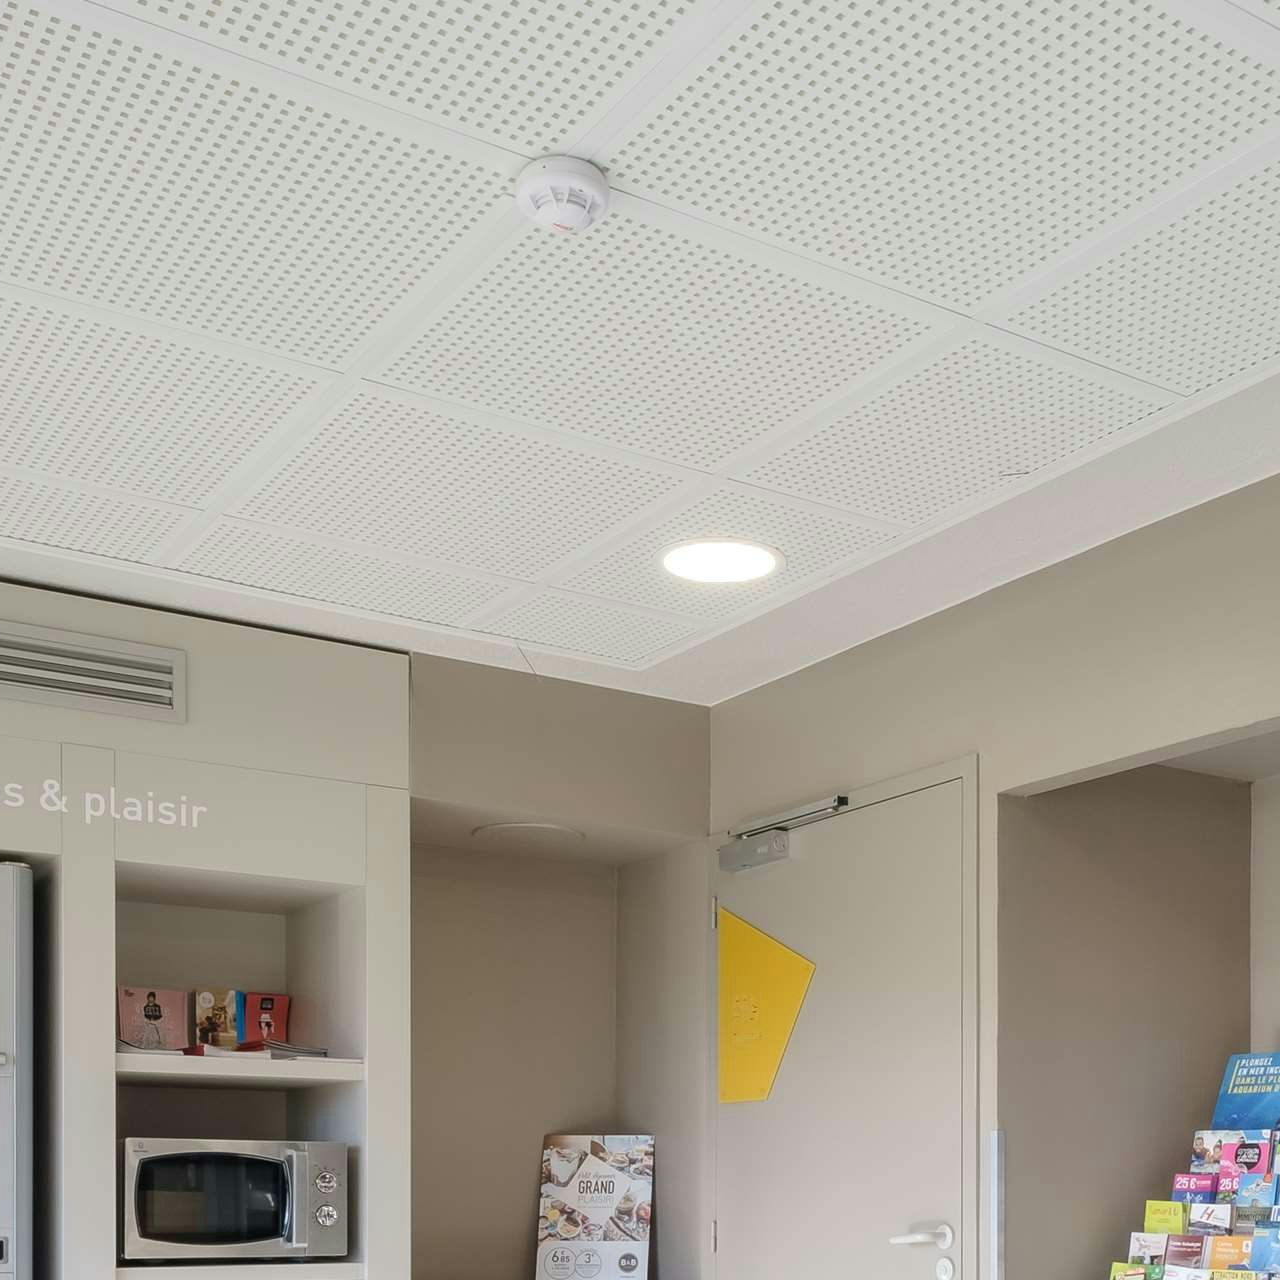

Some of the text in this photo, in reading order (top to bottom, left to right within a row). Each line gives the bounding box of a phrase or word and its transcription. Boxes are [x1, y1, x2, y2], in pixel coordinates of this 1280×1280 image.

[39, 779, 69, 814] &
[84, 786, 208, 828] plaisir
[1239, 1057, 1273, 1067] PLONGEZ
[1237, 1067, 1247, 1075] EN
[1249, 1066, 1264, 1075] MER
[1235, 1076, 1255, 1085] DANS
[1233, 1085, 1273, 1094] AQUARIUM
[578, 1180, 615, 1194] GRAND
